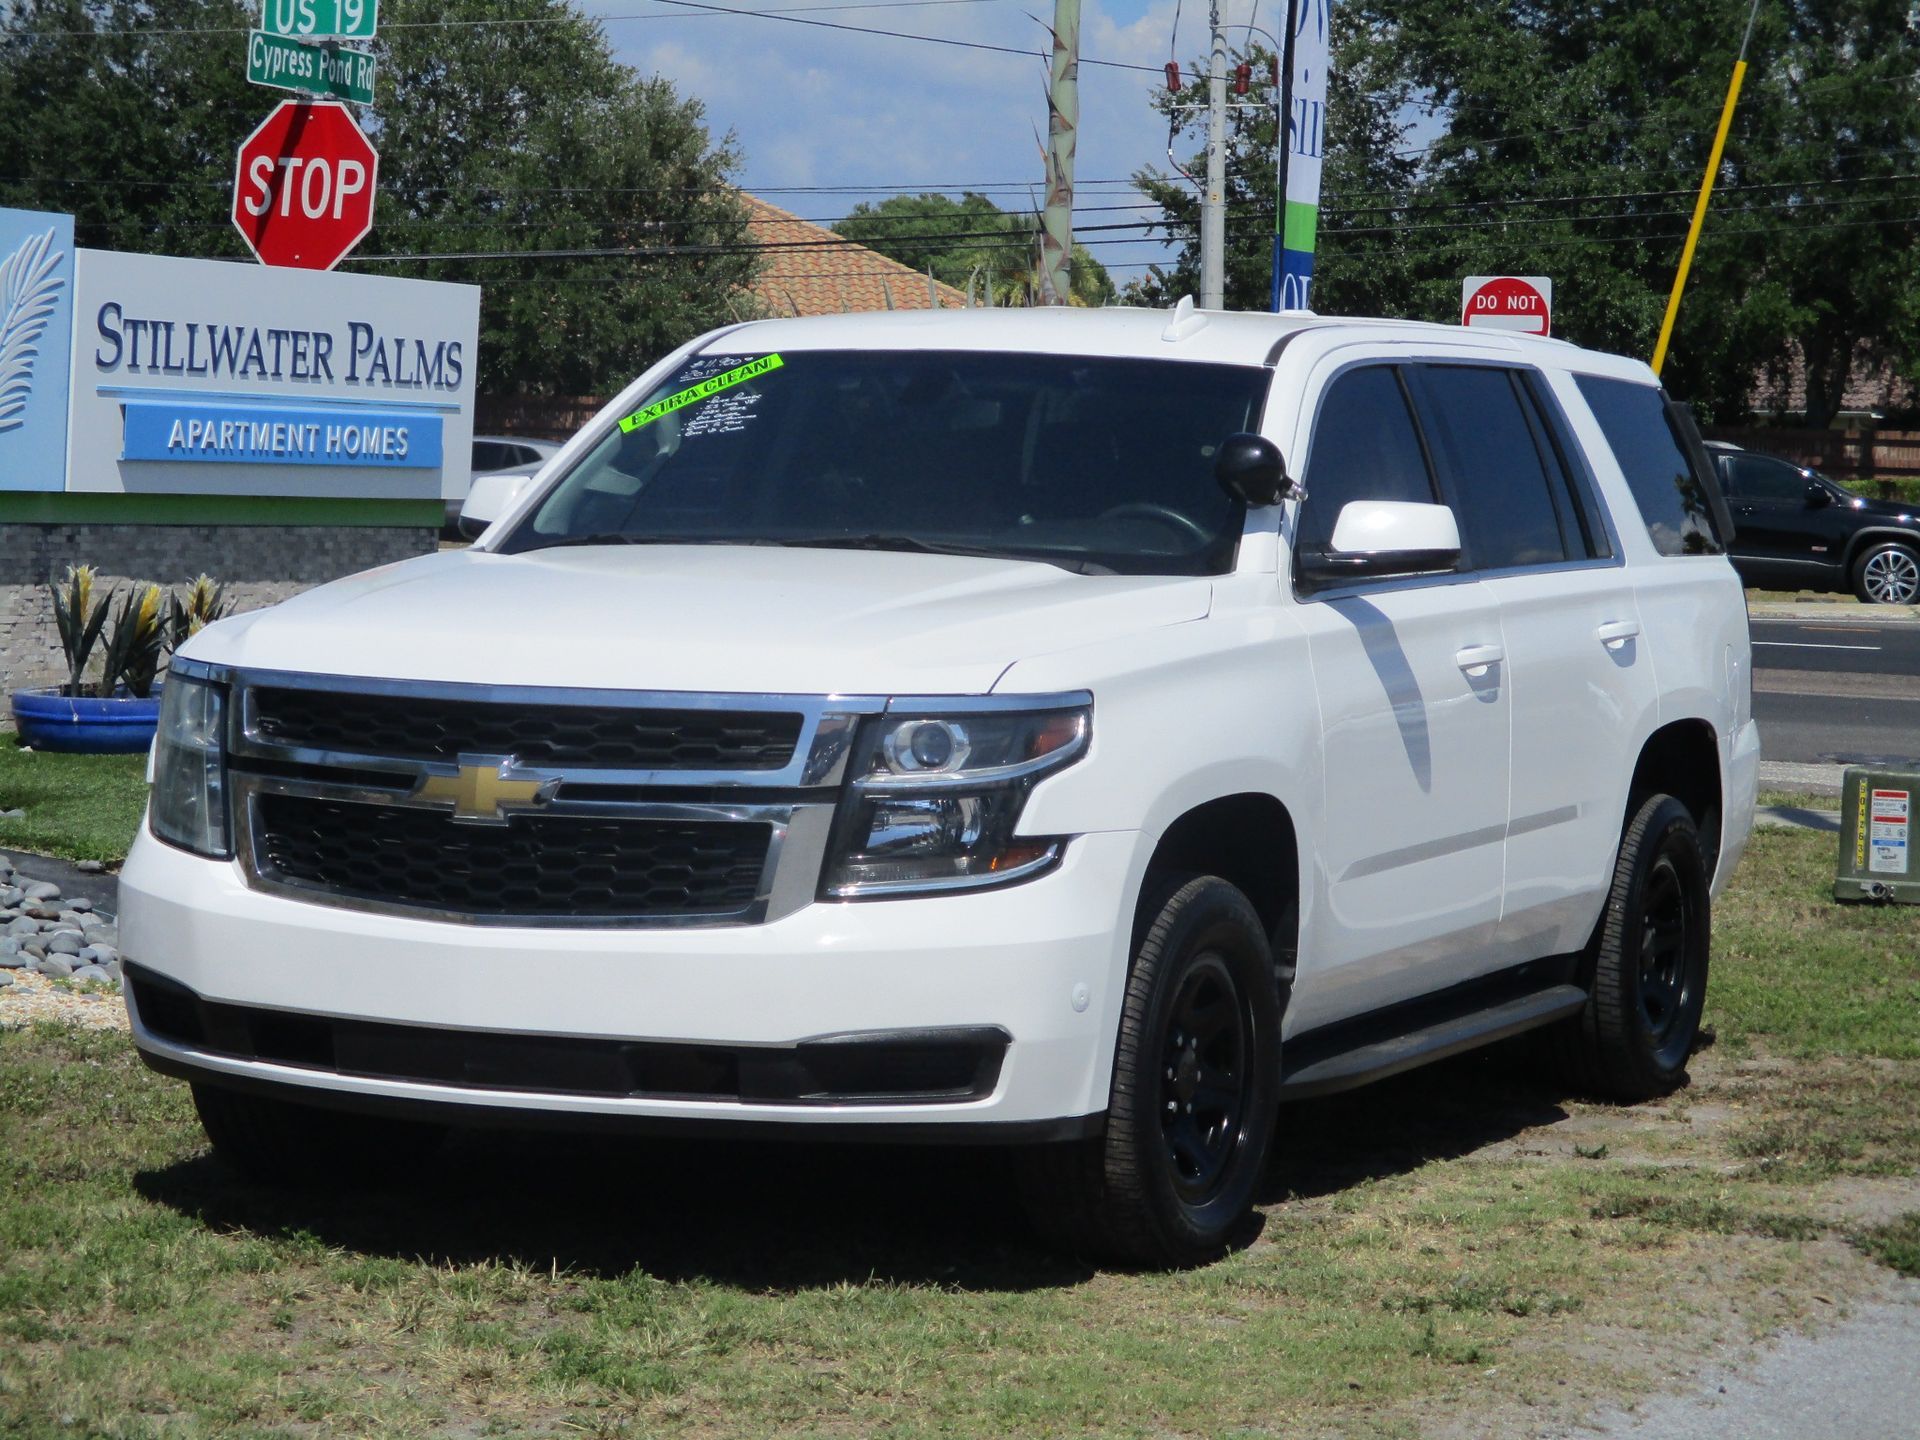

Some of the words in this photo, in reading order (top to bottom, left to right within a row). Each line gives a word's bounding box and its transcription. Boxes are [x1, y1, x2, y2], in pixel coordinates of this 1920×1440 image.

[275, 0, 316, 34] US
[334, 0, 364, 34] 19
[252, 35, 312, 80] Cypress
[319, 49, 352, 86] Pond
[357, 57, 373, 91] Rd
[244, 155, 365, 219] STOP
[1476, 294, 1498, 310] DO
[1507, 295, 1538, 310] NOT
[96, 302, 334, 379] STILLWATER
[345, 321, 463, 389] PALMS
[631, 388, 699, 426] EXTRA
[167, 419, 320, 455] APARTMENT
[326, 425, 409, 458] HOMES
